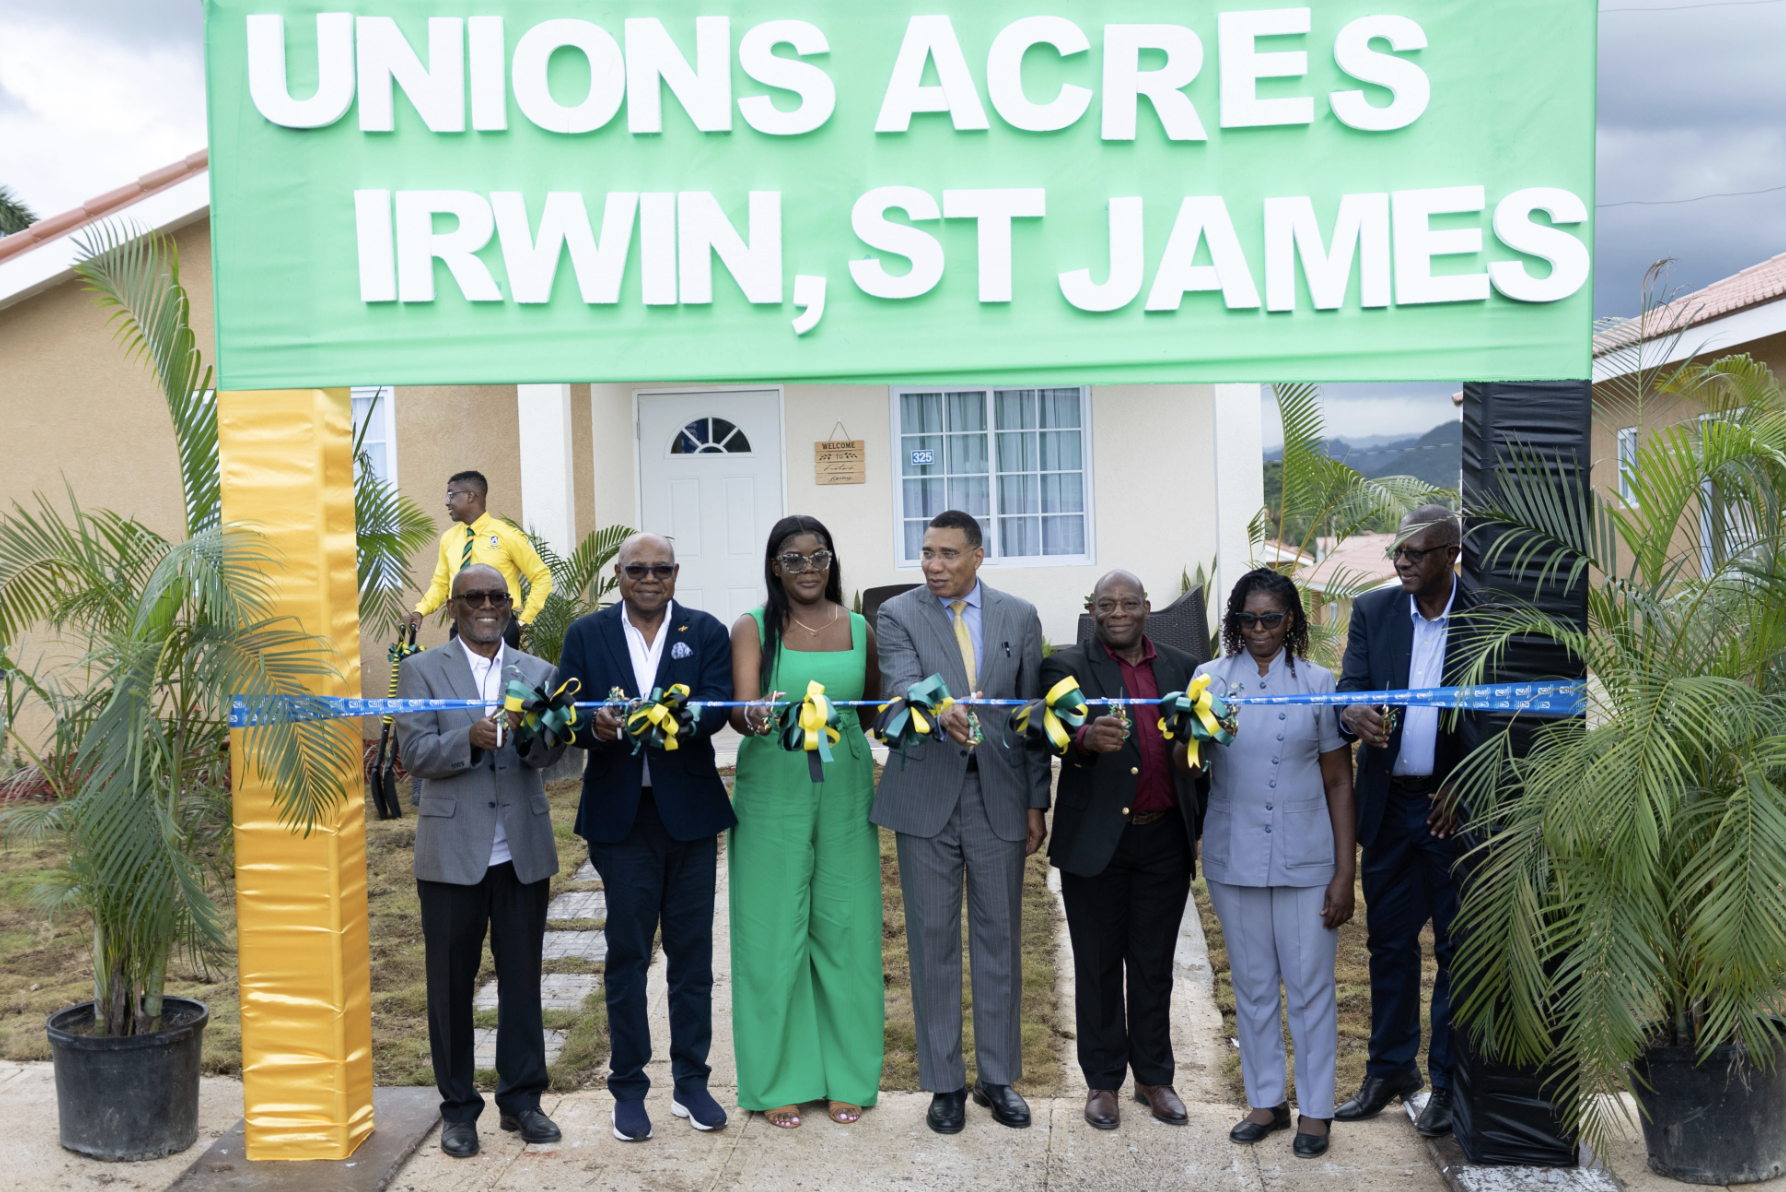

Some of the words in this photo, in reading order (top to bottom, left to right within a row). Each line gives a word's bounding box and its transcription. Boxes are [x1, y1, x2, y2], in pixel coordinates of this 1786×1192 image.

[246, 12, 836, 136] UNIONS
[874, 8, 1430, 140] ACRES
[354, 189, 827, 335] IRWIN,
[848, 186, 1046, 303] ST
[1058, 185, 1590, 312] JAMES
[822, 441, 855, 450] WELCOME
[913, 451, 932, 463] 325
